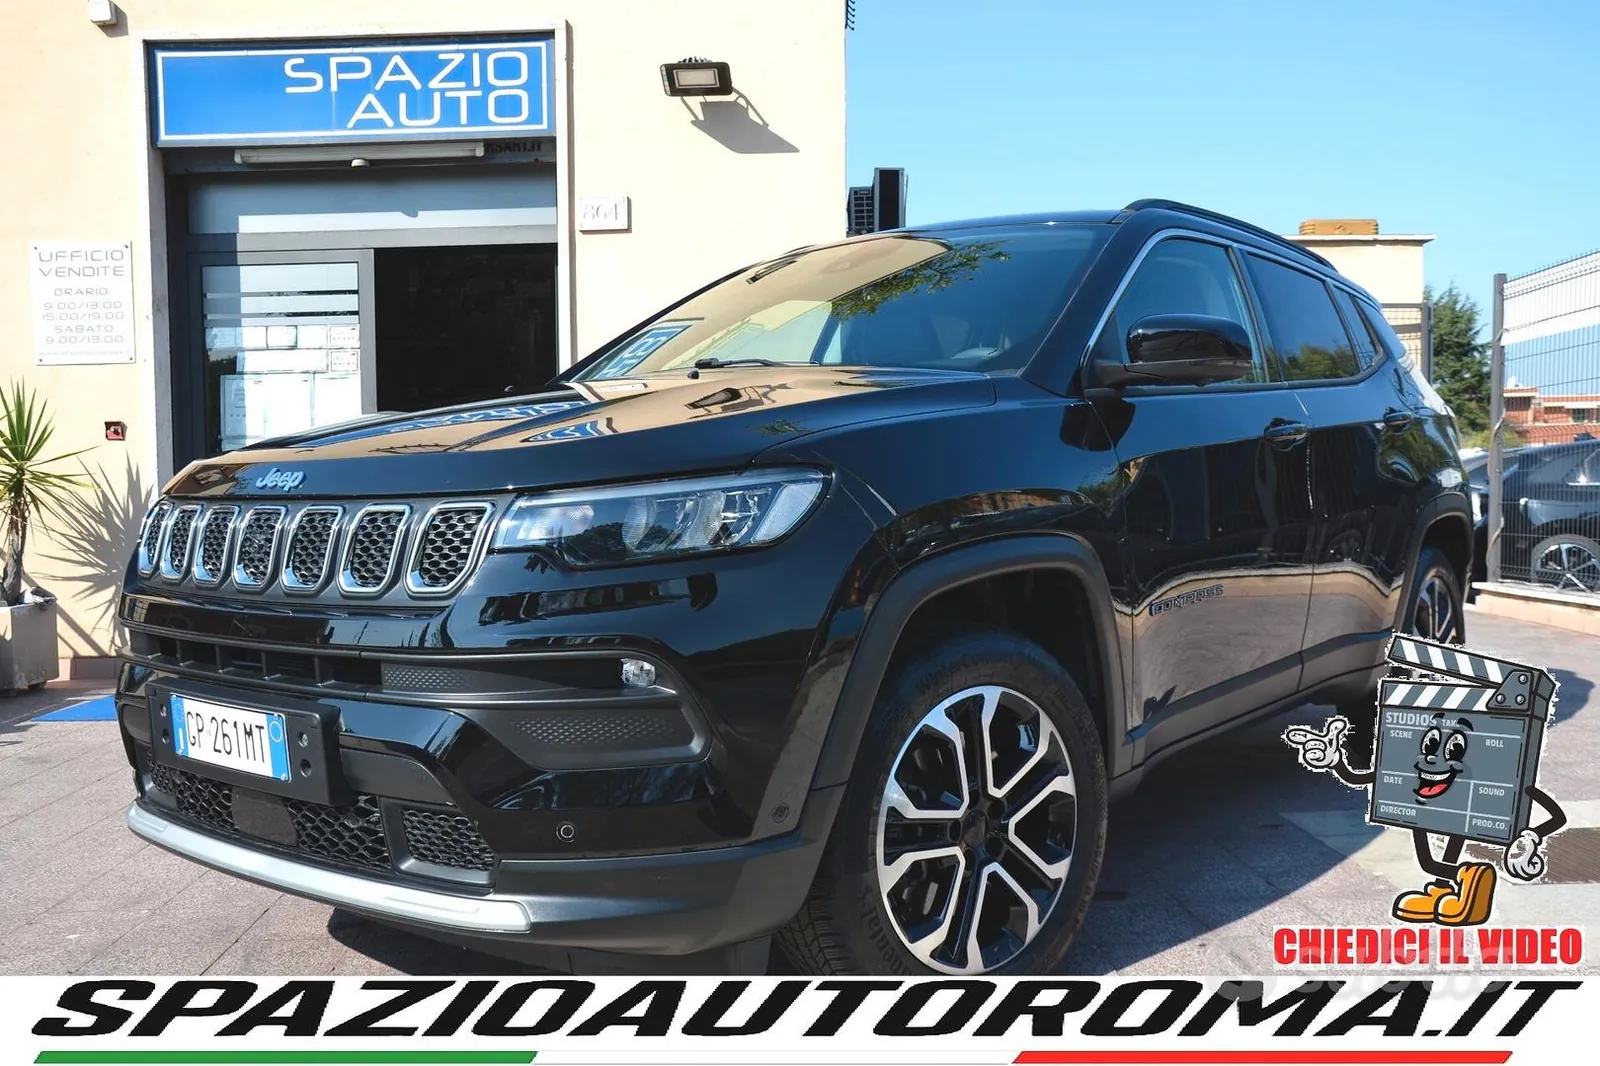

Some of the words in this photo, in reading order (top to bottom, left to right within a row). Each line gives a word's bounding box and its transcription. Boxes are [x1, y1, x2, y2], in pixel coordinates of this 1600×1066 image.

[284, 50, 529, 93] SPAZIO
[347, 88, 529, 128] AUTO
[38, 249, 125, 262] UFFICIO
[38, 265, 125, 278] VENDITE
[53, 287, 109, 297] ORARIO
[54, 324, 114, 334] SABATO
[255, 467, 305, 492] Jeep
[210, 716, 266, 763] 261MT
